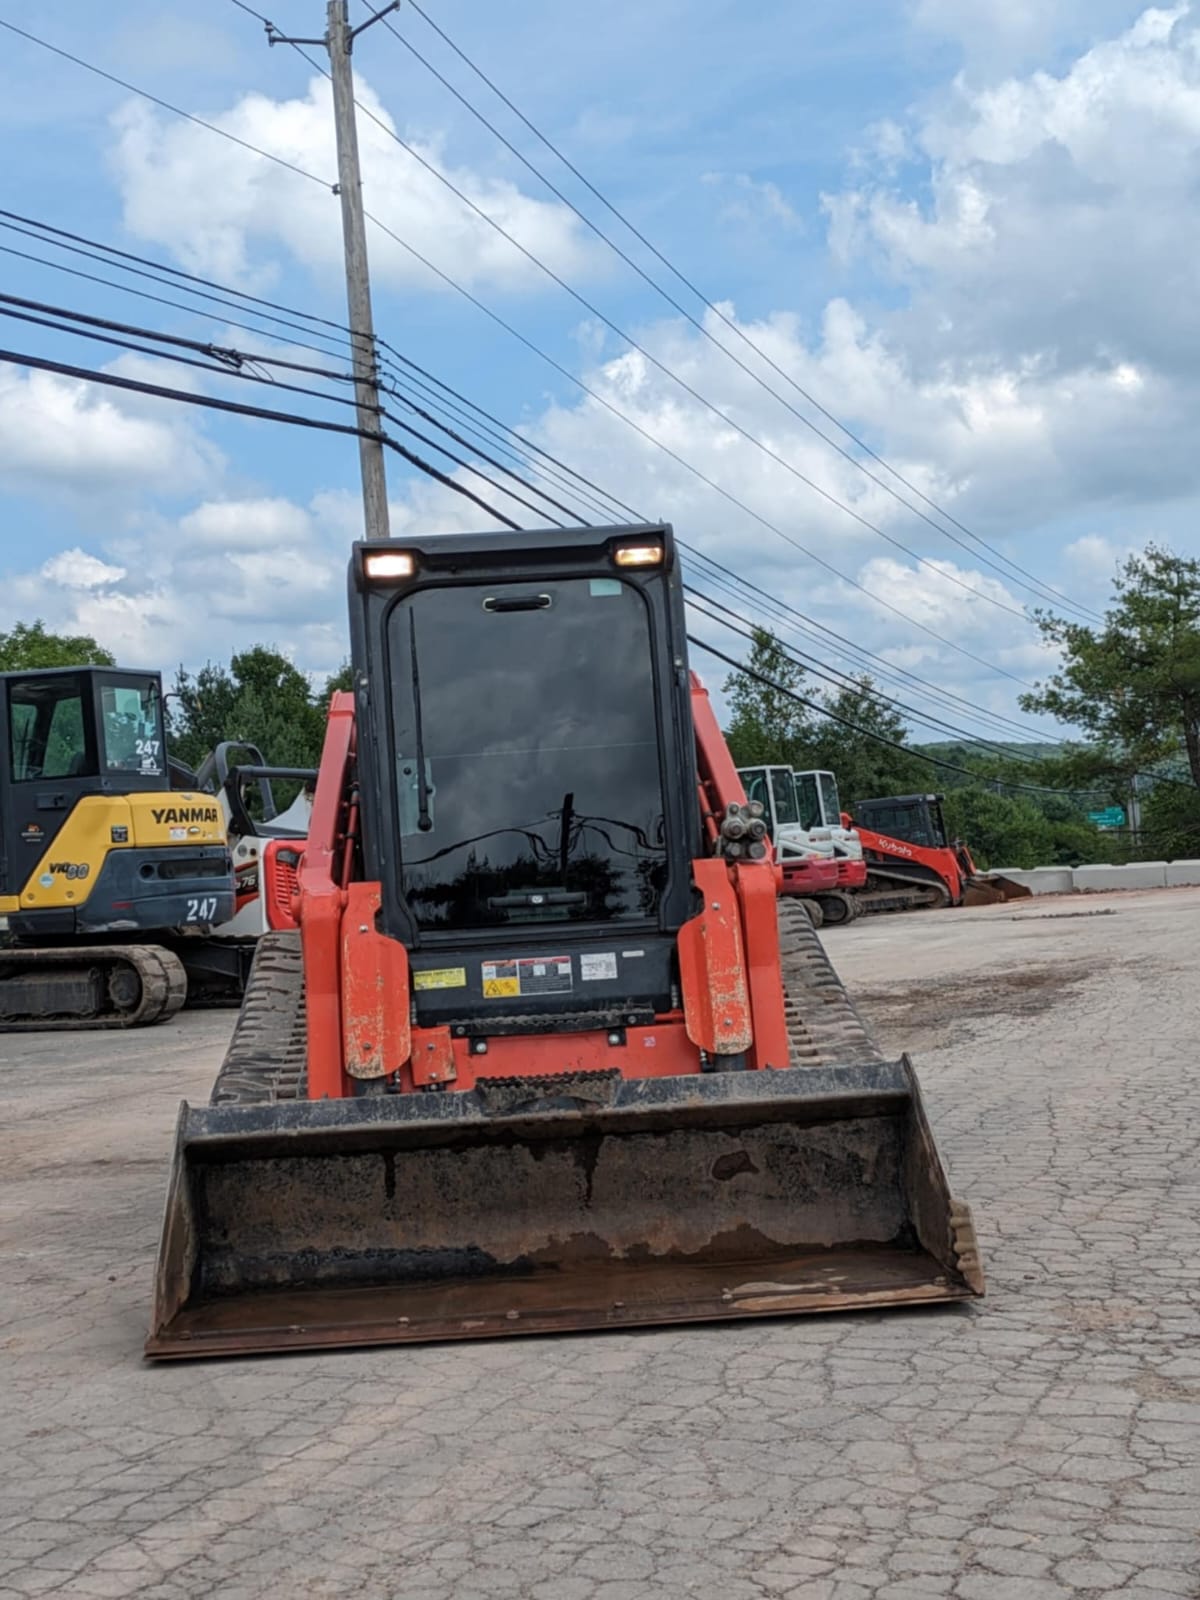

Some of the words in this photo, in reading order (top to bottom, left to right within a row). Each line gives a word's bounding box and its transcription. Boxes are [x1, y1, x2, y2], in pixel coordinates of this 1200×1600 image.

[135, 739, 160, 756] 247
[151, 808, 219, 825] YANMAR
[879, 838, 912, 856] Kubota
[187, 897, 217, 922] 247
